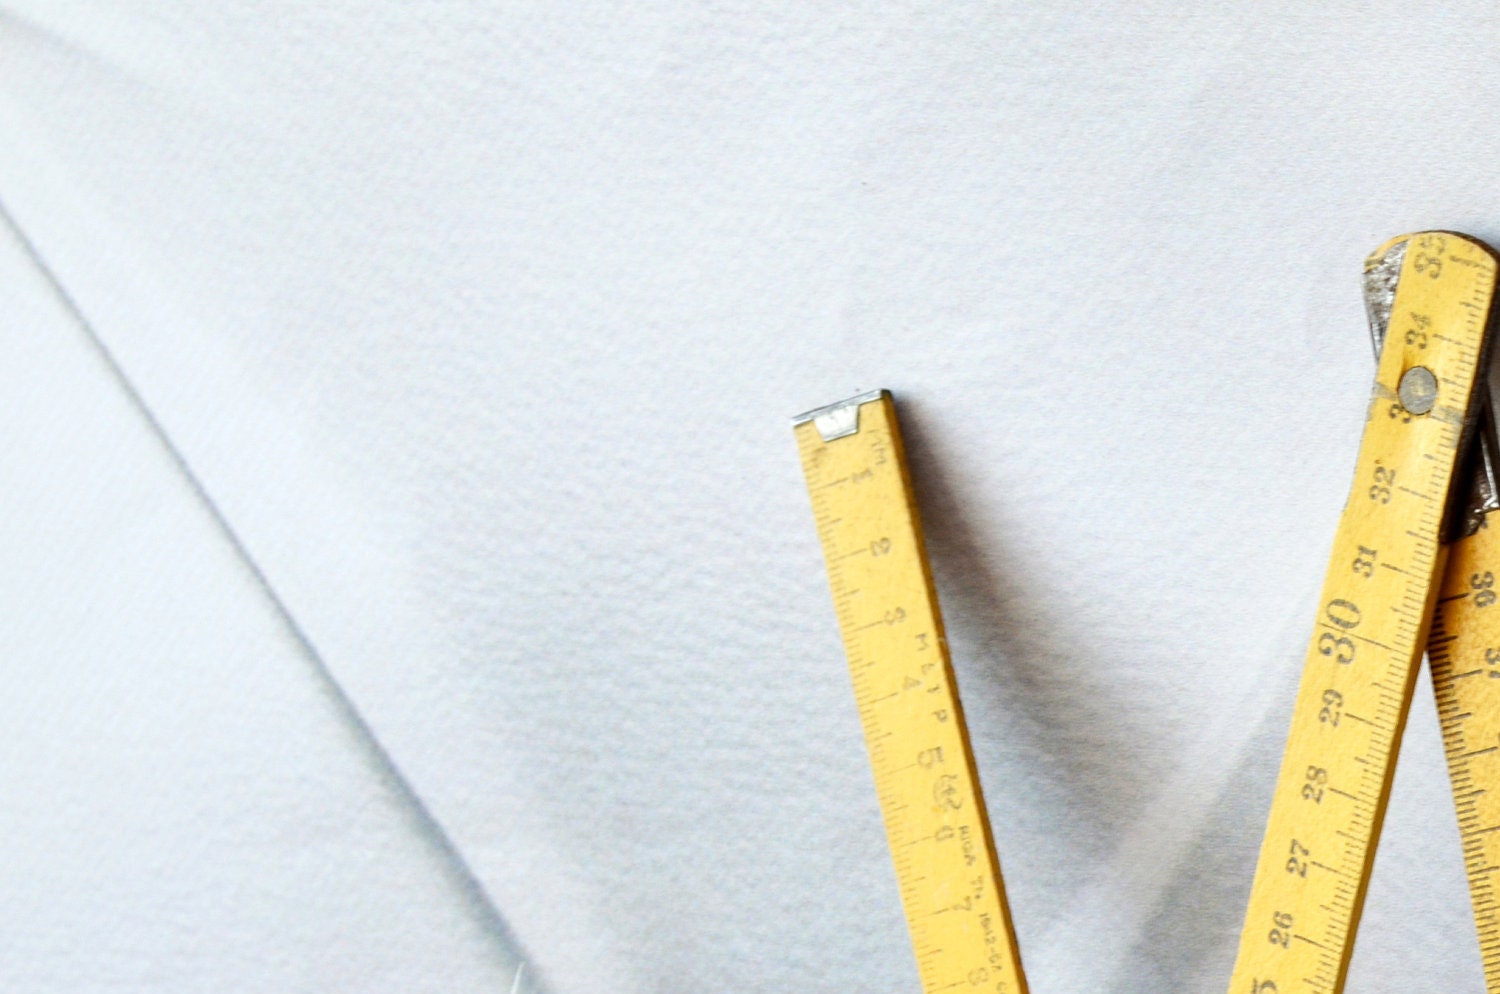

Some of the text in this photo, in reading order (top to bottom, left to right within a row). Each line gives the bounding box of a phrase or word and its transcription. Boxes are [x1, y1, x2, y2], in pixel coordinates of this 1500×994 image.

[1403, 311, 1430, 350] 34
[1368, 464, 1396, 505] 32
[1350, 543, 1378, 578] 31
[1468, 569, 1497, 608] 36
[1317, 597, 1361, 665] 30
[1317, 687, 1344, 728] 29
[869, 535, 891, 557] 2
[883, 606, 907, 626] 3
[900, 674, 922, 691] 4
[916, 744, 945, 769] 5
[950, 894, 972, 912] 7
[966, 965, 990, 987] 8
[1300, 764, 1327, 804] 28
[1284, 837, 1310, 878] 27
[1266, 909, 1294, 949] 26
